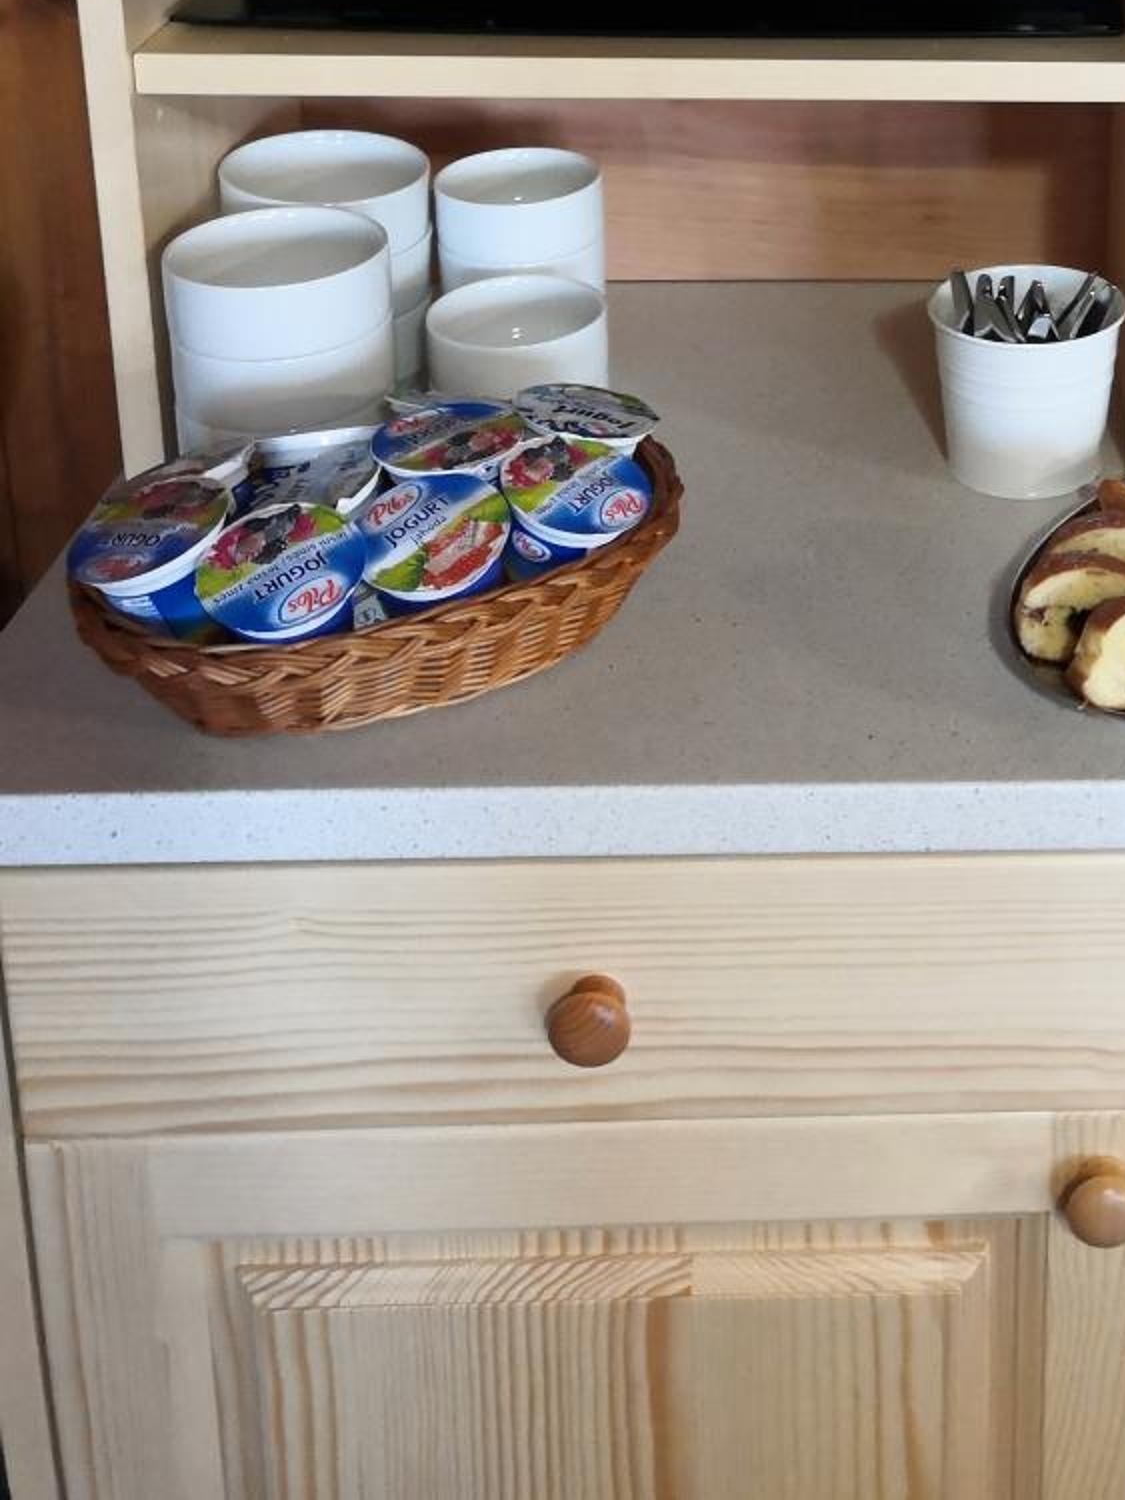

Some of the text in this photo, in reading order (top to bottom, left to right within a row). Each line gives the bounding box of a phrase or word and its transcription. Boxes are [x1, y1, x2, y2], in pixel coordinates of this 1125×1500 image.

[368, 491, 413, 524] Pilos
[384, 495, 450, 549] JOGURT
[603, 493, 643, 524] Pilos
[253, 550, 329, 603] JOGURT
[286, 578, 343, 616] Pilos
